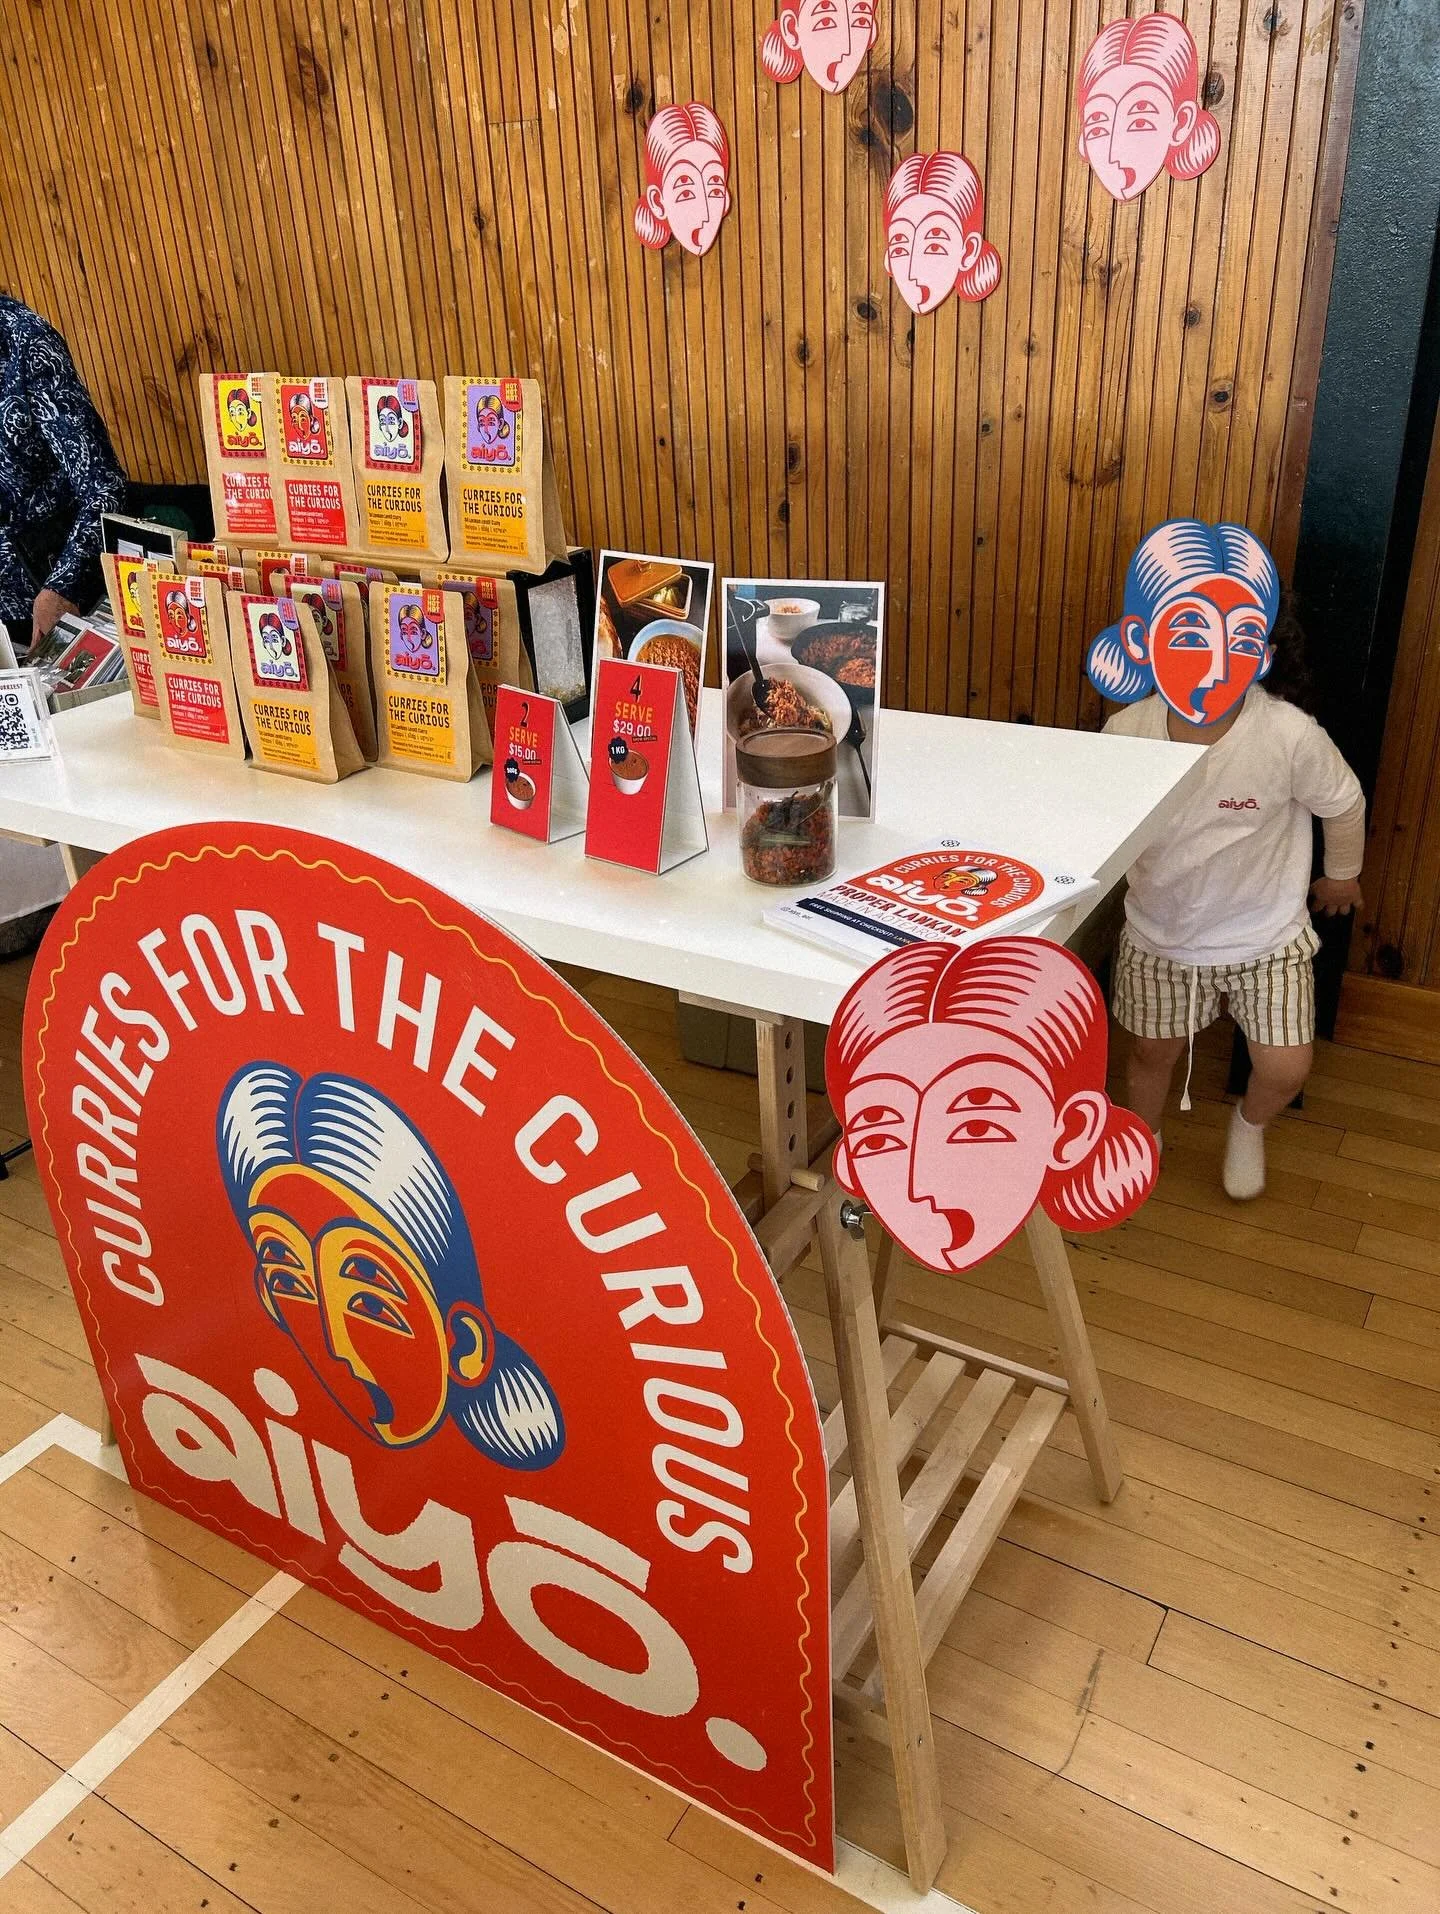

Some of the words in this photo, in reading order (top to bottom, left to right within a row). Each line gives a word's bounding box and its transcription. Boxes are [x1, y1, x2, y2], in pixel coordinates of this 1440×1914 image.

[225, 476, 261, 488] CURRIES
[288, 484, 321, 496] CURRIES
[324, 485, 338, 496] FOR
[226, 488, 242, 500] THE
[246, 489, 273, 500] CURIO
[367, 484, 402, 498] CURRIES
[405, 487, 421, 499] FOR
[463, 488, 501, 503] CURRIES
[504, 492, 522, 504] FOR
[289, 497, 305, 508] THE
[307, 497, 340, 510] CURIOUS
[368, 498, 382, 509] THE
[385, 499, 422, 513] CURIOUS
[463, 502, 480, 515] THE
[482, 504, 523, 519] CURIOUS
[135, 663, 146, 675] THE
[168, 677, 202, 693] CURRIES
[205, 682, 219, 695] FOR
[630, 673, 643, 703] 4
[171, 690, 186, 702] THE
[188, 693, 222, 707] CURIOUS
[388, 695, 428, 712] CURRIES
[431, 702, 449, 715] FOR
[254, 704, 290, 719] CURRIES
[294, 709, 310, 722] FOR
[389, 708, 406, 722] THE
[408, 712, 450, 728] CURIOUS
[521, 702, 529, 728] 2
[615, 701, 653, 723] SERVE
[256, 716, 271, 729] THE
[274, 720, 311, 736] CURIOUS
[613, 719, 651, 736] $29.00
[509, 726, 538, 748] SERVE
[509, 743, 536, 760] $15.00
[894, 855, 960, 874] CURRIES
[964, 855, 998, 866] FOR
[997, 862, 1026, 878] THE
[990, 877, 1032, 908] CURIOUS
[816, 892, 852, 908] MADE
[858, 902, 874, 915] IN
[828, 885, 897, 912] PROPER
[893, 908, 967, 938] LANKAN
[71, 975, 171, 1307] CURRIES
[140, 908, 302, 1032] FOR
[318, 921, 515, 1117] THE
[514, 1094, 753, 1574] CURIOUS
